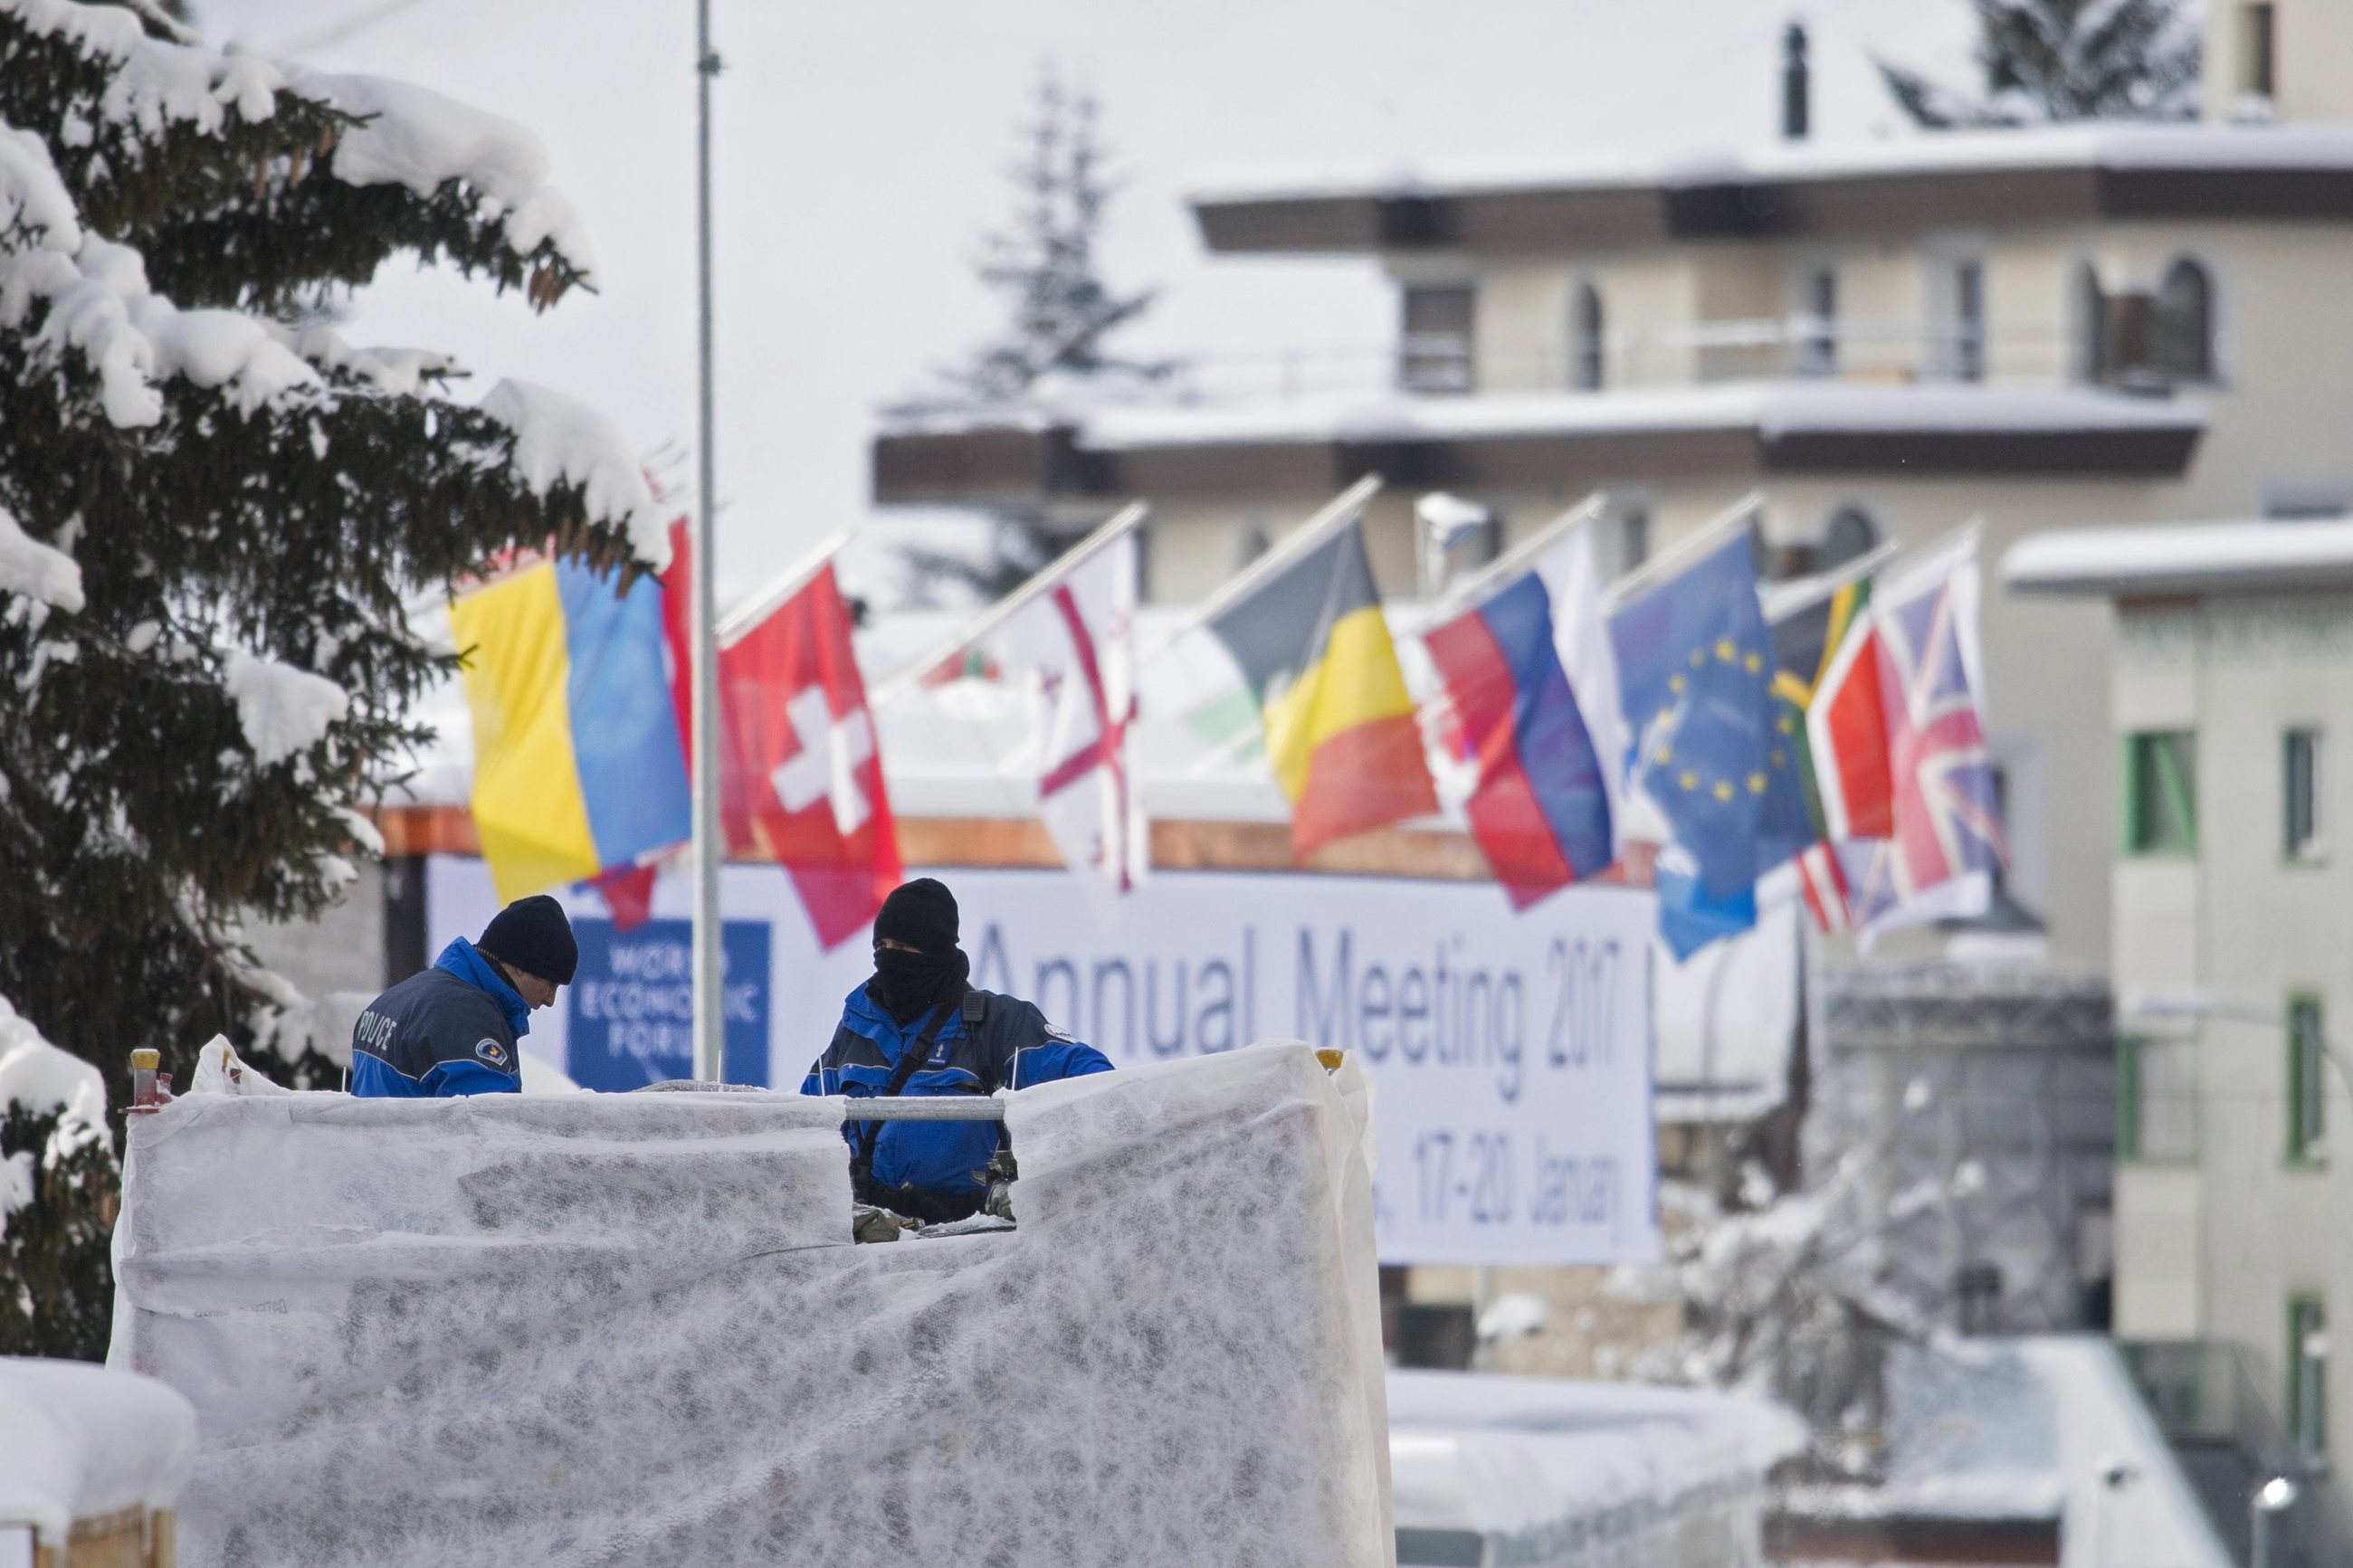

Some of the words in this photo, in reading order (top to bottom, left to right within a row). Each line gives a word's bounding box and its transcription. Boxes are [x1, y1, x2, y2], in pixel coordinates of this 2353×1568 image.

[357, 1011, 397, 1050] POLICE
[580, 981, 757, 1022] ECONOIC
[1294, 927, 1524, 1104] Meeting
[1547, 936, 1620, 1069] 2017
[1413, 1131, 1517, 1223] 17-20
